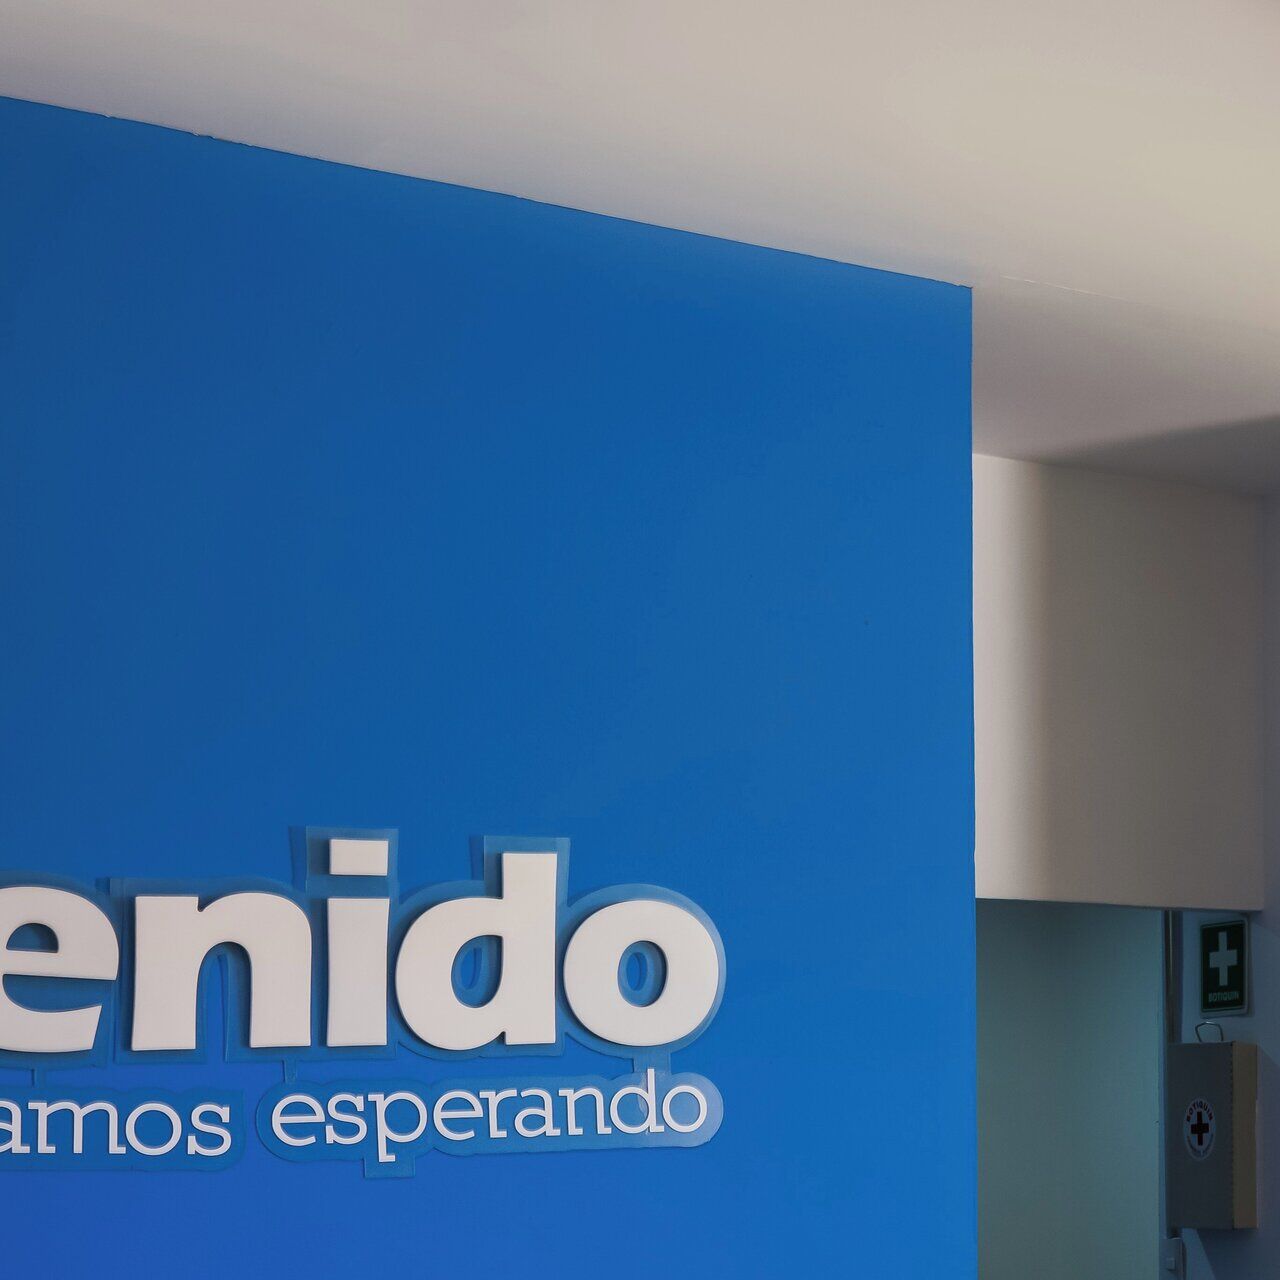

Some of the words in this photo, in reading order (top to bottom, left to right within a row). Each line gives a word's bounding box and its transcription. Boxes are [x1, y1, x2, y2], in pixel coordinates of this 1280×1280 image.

[0, 838, 720, 1054] enido
[0, 1100, 232, 1157] amos
[270, 1068, 708, 1163] esperando
